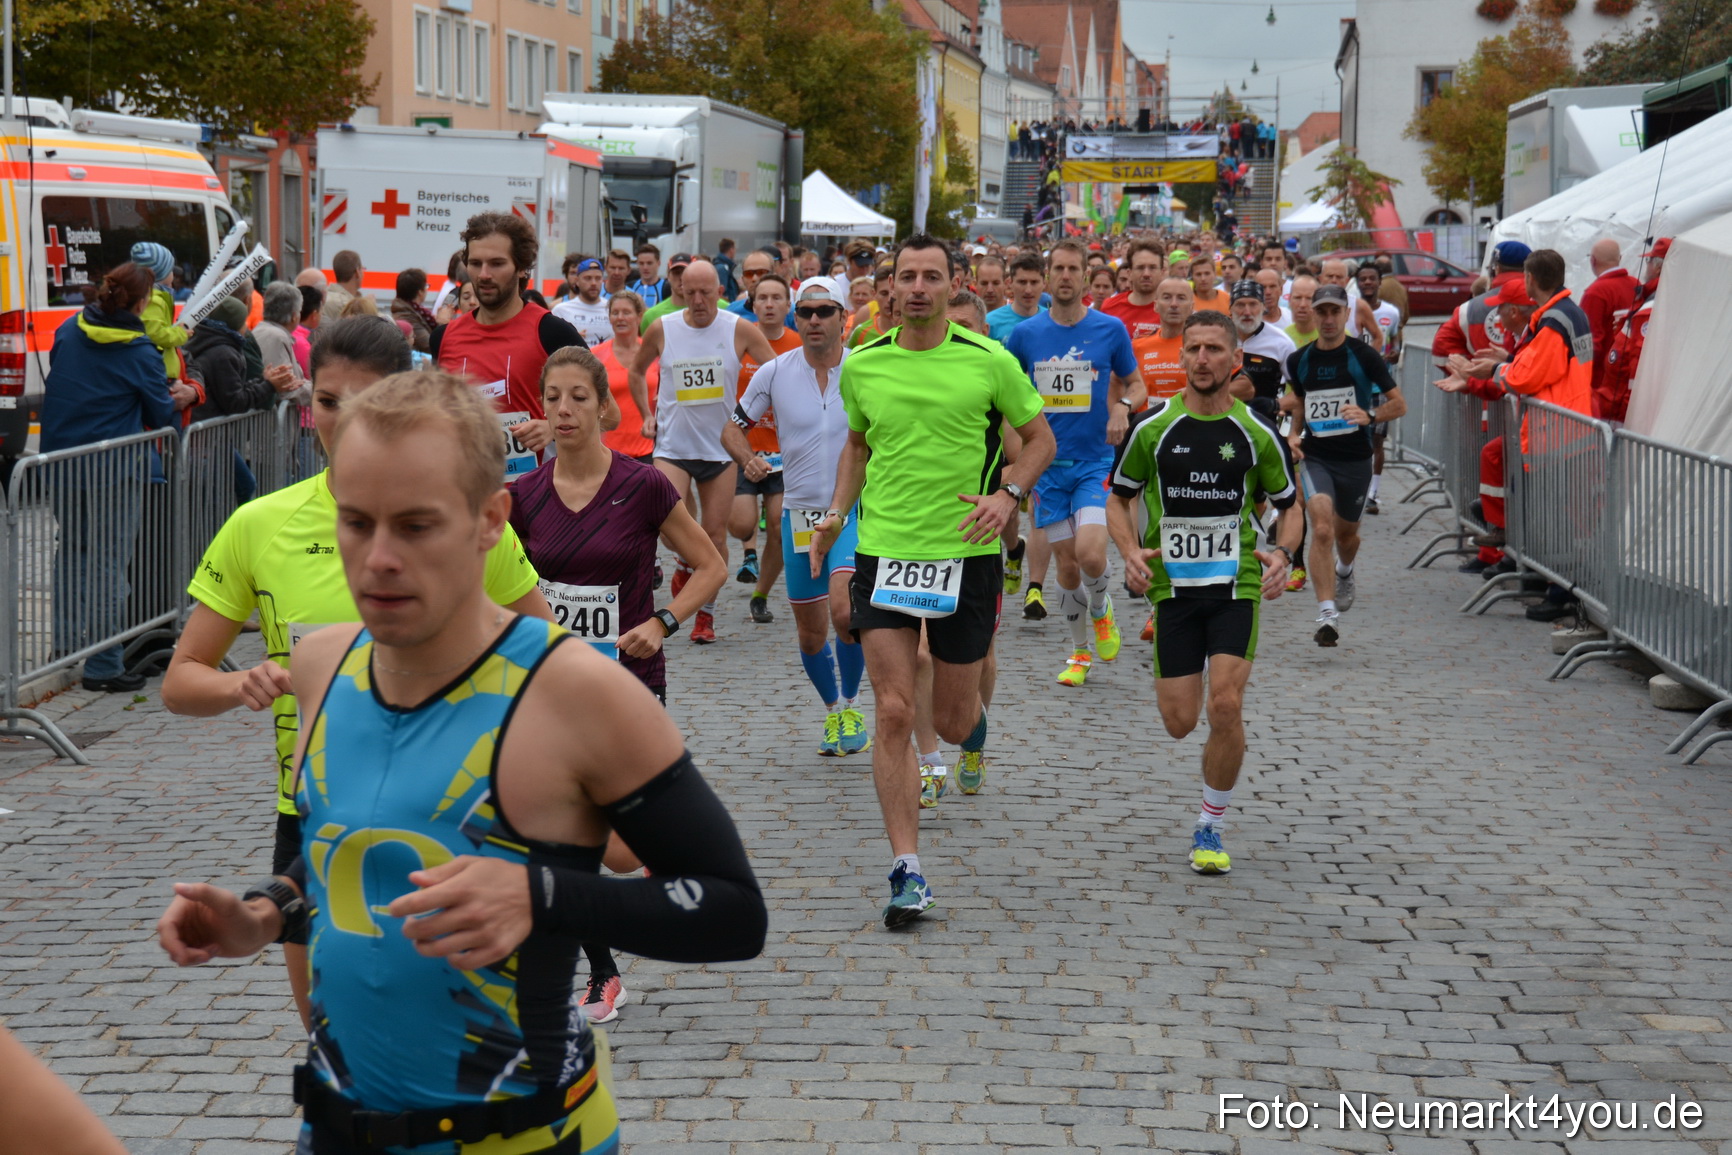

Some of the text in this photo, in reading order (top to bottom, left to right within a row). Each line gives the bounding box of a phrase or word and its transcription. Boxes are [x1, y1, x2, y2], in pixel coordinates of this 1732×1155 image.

[1112, 165, 1165, 179] START
[417, 190, 490, 205] Bayerisches
[416, 205, 451, 217] Rotes
[416, 221, 451, 233] Kreuz
[806, 222, 854, 232] Laufsport
[68, 246, 87, 264] Rotes
[70, 266, 88, 284] Kreuz
[190, 254, 266, 322] bmw-laufsport.de
[683, 368, 715, 388] 534
[1052, 373, 1074, 392] 46
[1052, 397, 1073, 406] Mario
[1310, 399, 1349, 419] 237
[1189, 471, 1220, 484] DAV
[1166, 486, 1238, 501] Röthenbach
[1162, 523, 1227, 531] PARTL Neumarkt
[1169, 532, 1233, 559] 3014
[884, 560, 952, 592] 2691
[558, 591, 602, 603] Neumarkt
[889, 593, 939, 609] Reinhard
[548, 601, 610, 639] 240
